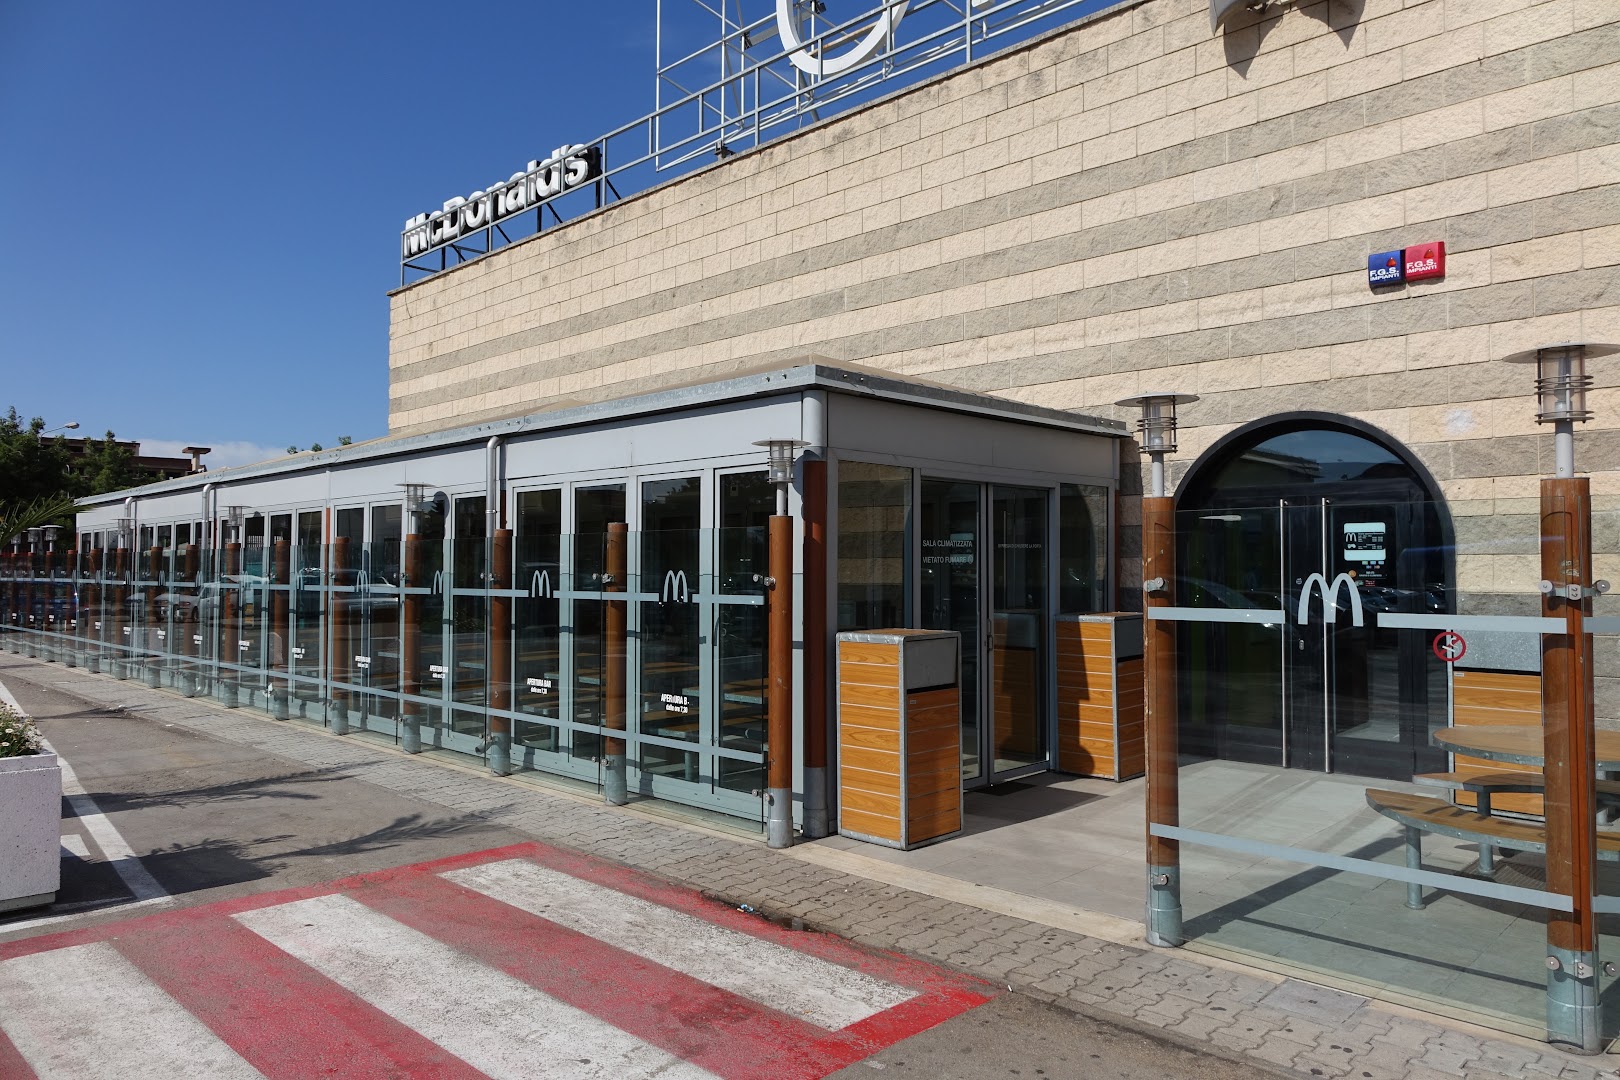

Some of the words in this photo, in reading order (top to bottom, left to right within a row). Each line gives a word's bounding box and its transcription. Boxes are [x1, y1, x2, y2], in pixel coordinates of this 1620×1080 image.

[1406, 259, 1437, 269] F.G.S.
[1369, 267, 1400, 277] F.G.S.
[1406, 265, 1437, 274] IMPIANTI
[1369, 272, 1400, 281] IMPIANTI
[937, 540, 973, 548] CLIMATIZZATA
